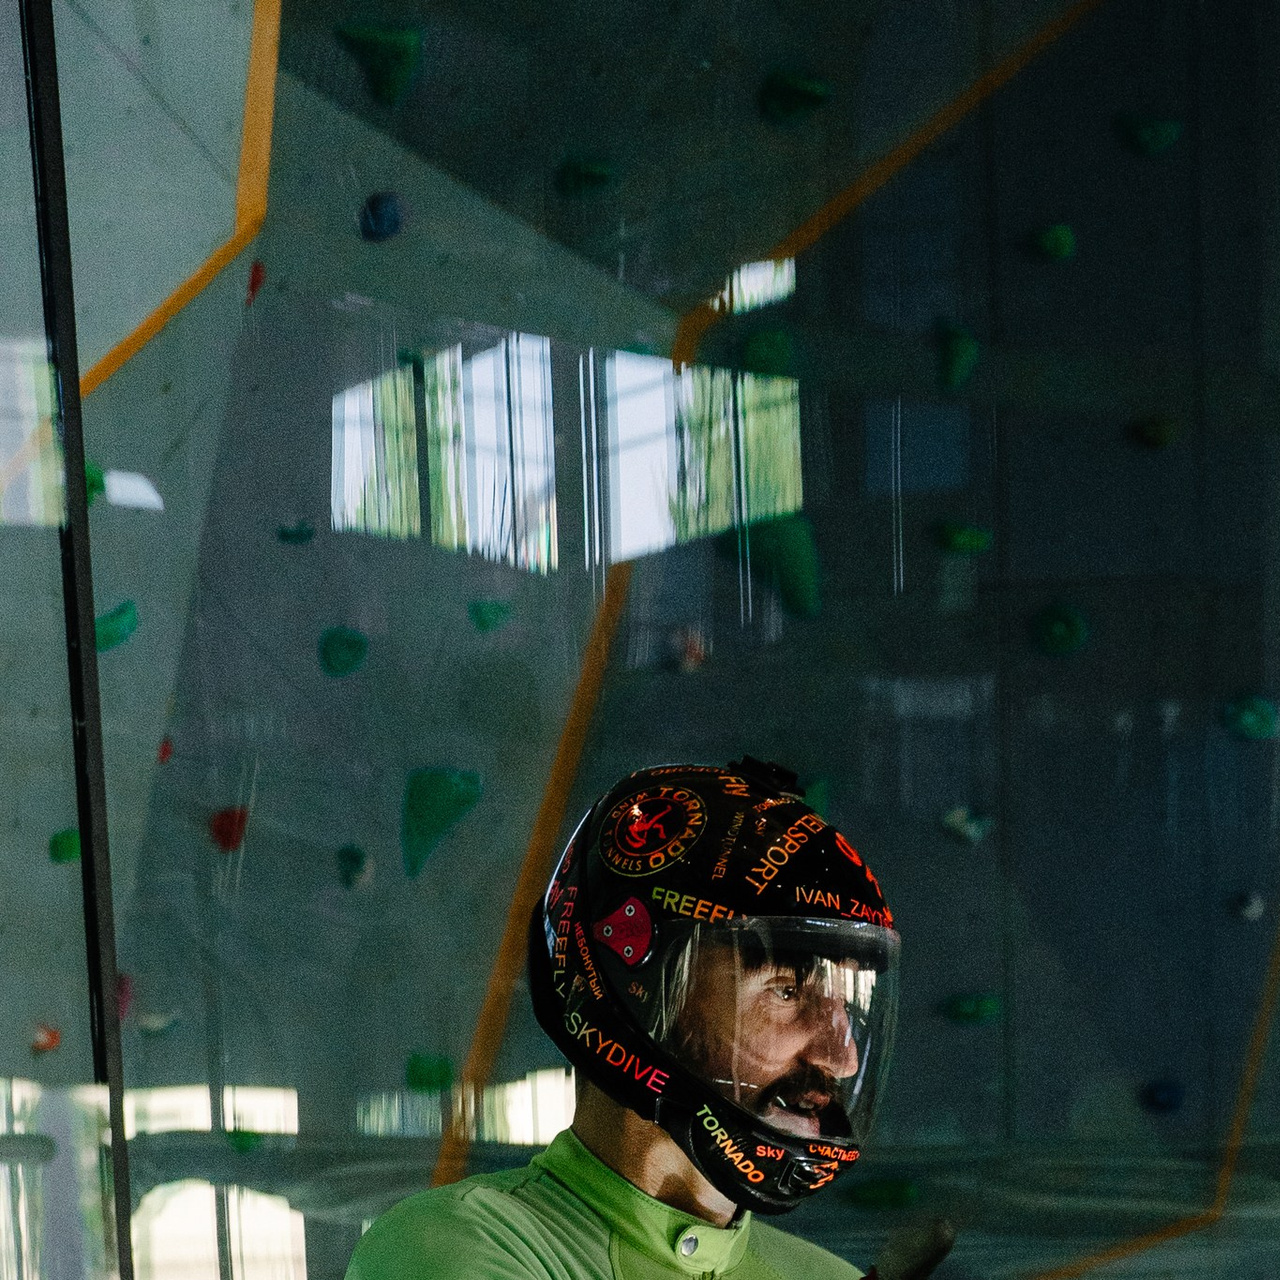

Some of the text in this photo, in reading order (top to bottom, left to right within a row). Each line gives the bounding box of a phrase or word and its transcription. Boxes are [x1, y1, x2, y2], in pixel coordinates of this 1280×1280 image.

[649, 786, 703, 869] TORNADO
[553, 885, 579, 998] FREEFLY
[564, 1011, 671, 1094] SKYDIVE
[696, 1103, 766, 1184] TORNADO
